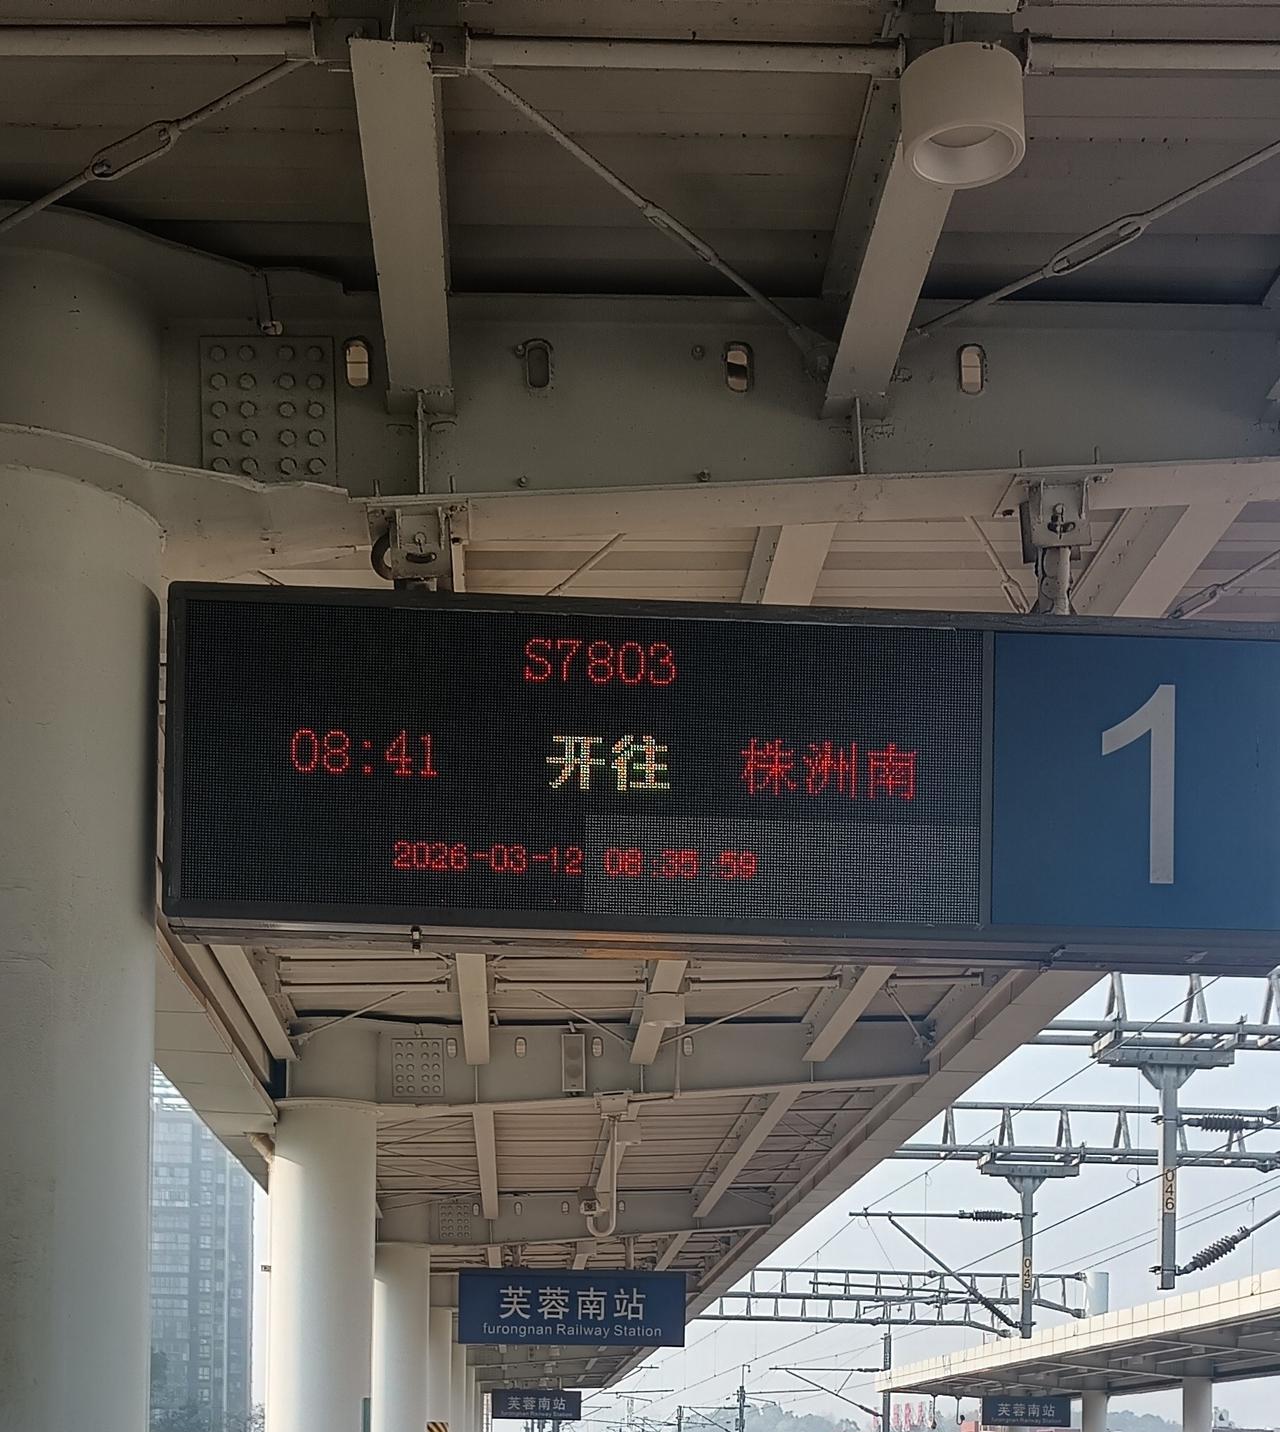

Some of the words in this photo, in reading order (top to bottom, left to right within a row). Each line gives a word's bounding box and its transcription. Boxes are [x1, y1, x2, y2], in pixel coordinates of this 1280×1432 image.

[524, 638, 677, 686] S7803
[291, 727, 438, 778] 08:41
[546, 735, 670, 791] 开往
[740, 737, 917, 800] 株洲南
[1102, 684, 1176, 884] 1
[392, 838, 584, 876] 2026-03-12
[1164, 1168, 1175, 1211] 046
[1023, 1258, 1032, 1289] 045
[499, 1285, 646, 1320] 芙蓉南站
[483, 1322, 552, 1338] furongnan
[556, 1324, 611, 1339] Railway
[613, 1325, 662, 1338] Station
[507, 1396, 567, 1411] 芙蓉南站
[997, 1402, 1056, 1418] 芙蓉南站
